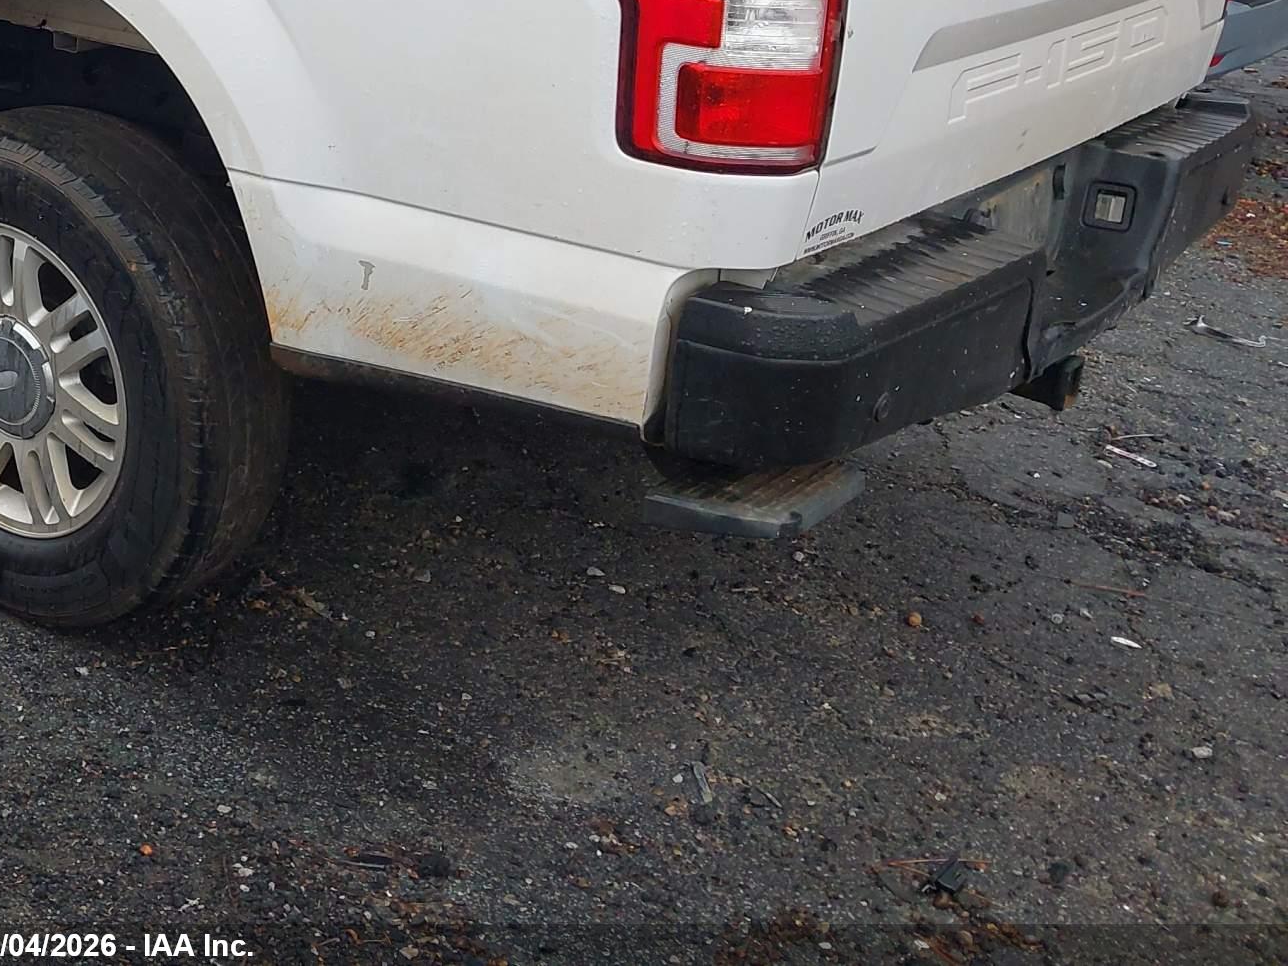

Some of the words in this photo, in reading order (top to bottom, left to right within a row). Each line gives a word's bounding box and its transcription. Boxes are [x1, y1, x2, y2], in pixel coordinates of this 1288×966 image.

[947, 4, 1169, 125] F-150
[804, 211, 844, 243] MOTOR
[843, 209, 864, 224] MAX
